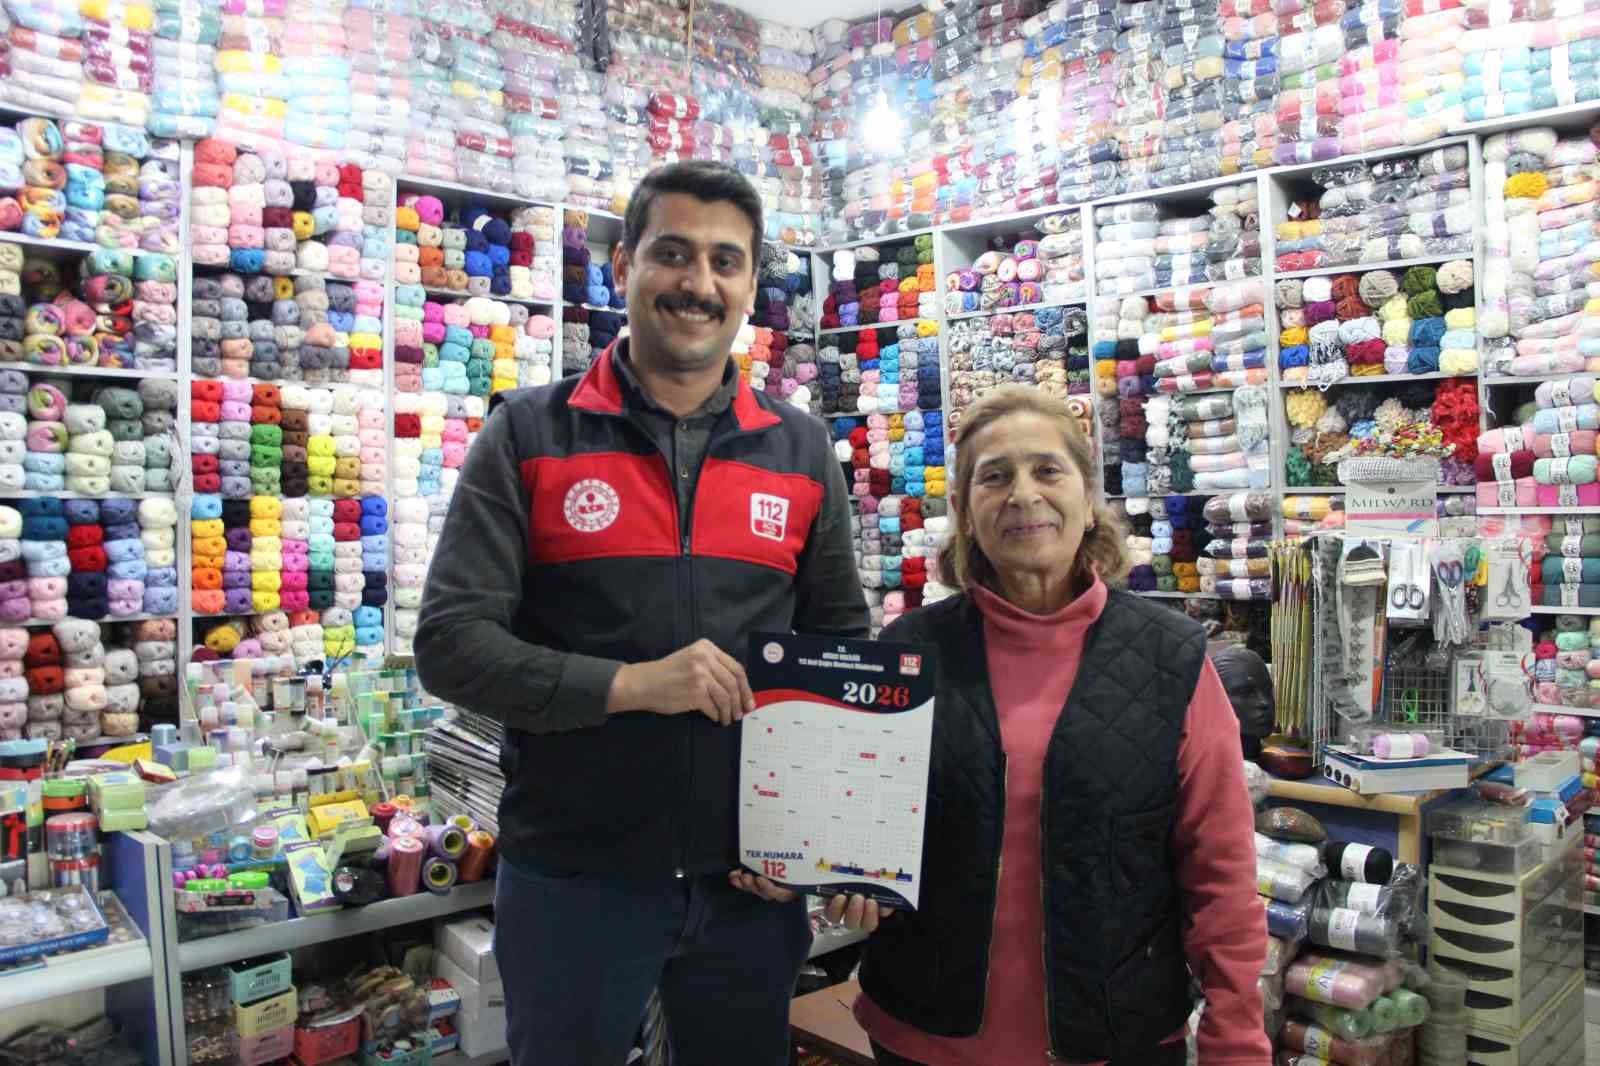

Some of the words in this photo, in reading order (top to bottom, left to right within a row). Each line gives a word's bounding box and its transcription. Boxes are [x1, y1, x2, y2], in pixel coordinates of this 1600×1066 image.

[758, 499, 783, 521] 112
[1352, 497, 1434, 508] MILWARD
[842, 681, 910, 707] 2026
[746, 850, 761, 858] TEK
[763, 851, 804, 860] NUMARA
[761, 860, 787, 879] 112
